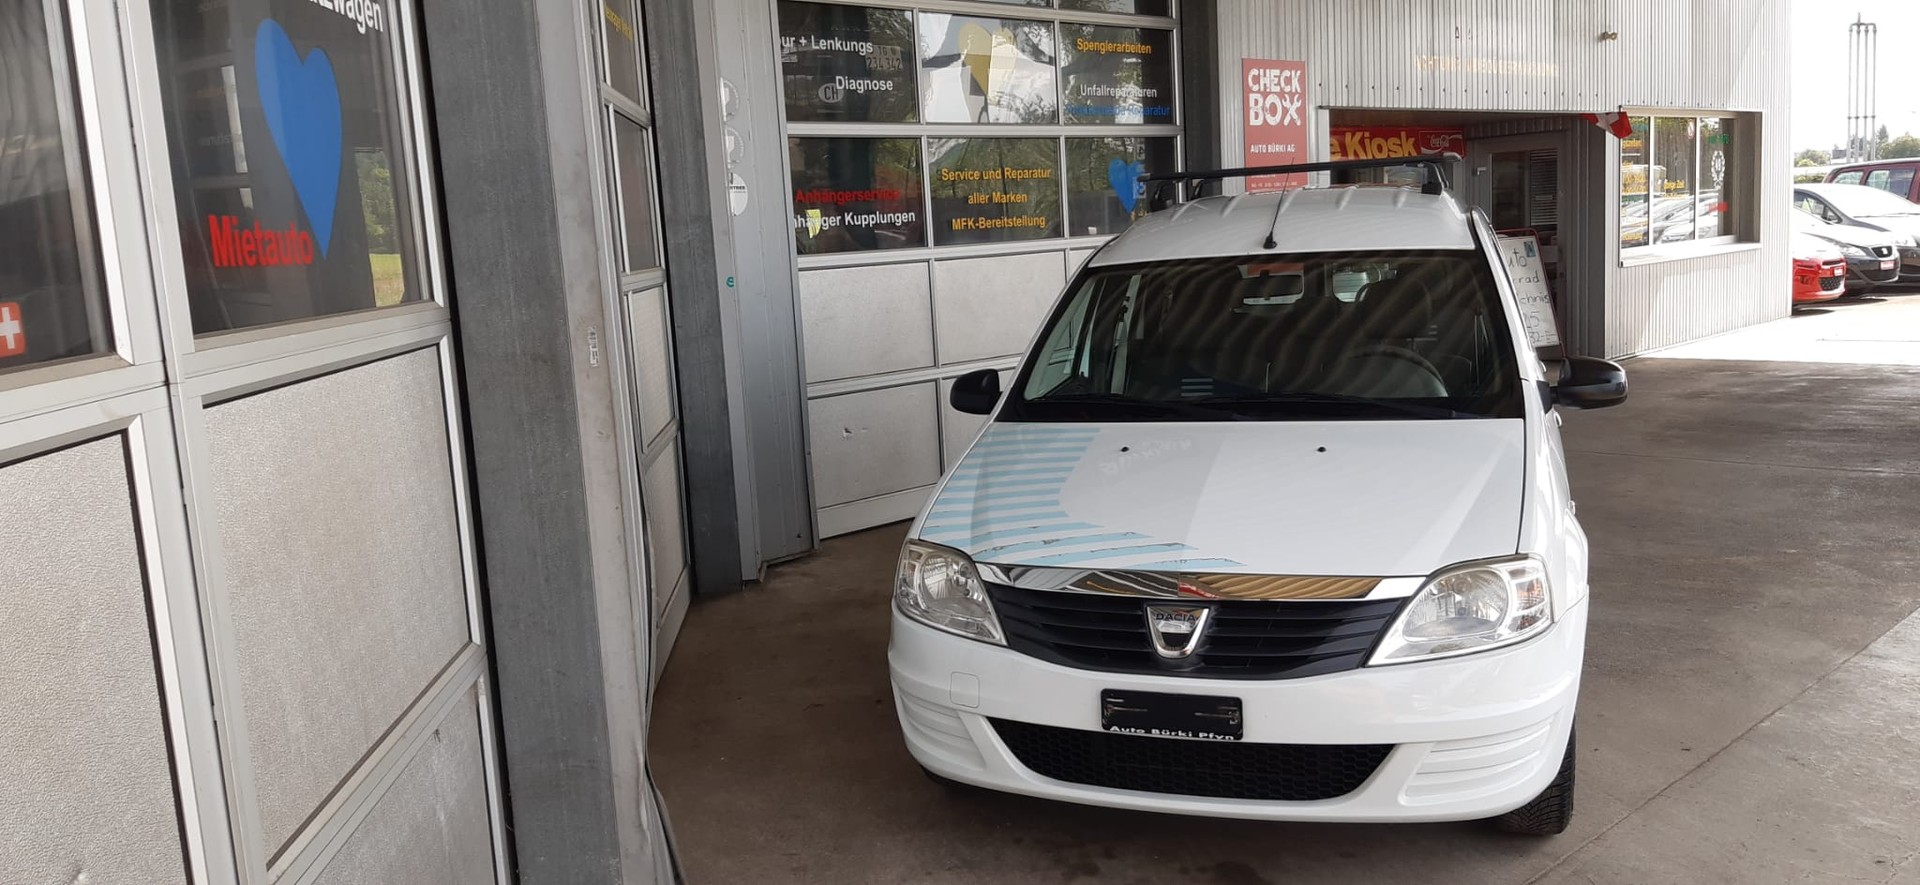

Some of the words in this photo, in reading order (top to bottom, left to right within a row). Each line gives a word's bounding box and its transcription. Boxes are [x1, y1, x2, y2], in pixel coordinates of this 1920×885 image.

[811, 34, 874, 56] Lenkungs
[1076, 37, 1152, 55] Spenglerarbeiten
[835, 76, 894, 94] Diagnose
[1248, 68, 1302, 93] CHECK
[1080, 83, 1158, 99] Unfallreparaturen
[1249, 93, 1302, 126] BOX
[1250, 143, 1267, 153] AUTO
[1267, 142, 1286, 153] BÜRKI
[1286, 143, 1296, 153] AG
[1344, 130, 1418, 160] Kiosk
[941, 167, 981, 182] Service
[983, 167, 1002, 180] und
[1004, 165, 1052, 181] Reparatur
[967, 193, 990, 205] aller
[992, 191, 1028, 204] Marken
[844, 210, 916, 228] Kupplungen
[952, 214, 1046, 231] MFK-Bereitstellung
[208, 214, 314, 268] Mietauto
[1508, 248, 1528, 268] uto
[1518, 270, 1540, 284] rad
[1155, 612, 1197, 622] DACIA
[1109, 725, 1146, 735] Auto
[1151, 728, 1193, 738] Bürki
[1198, 732, 1235, 741] Pfyn
